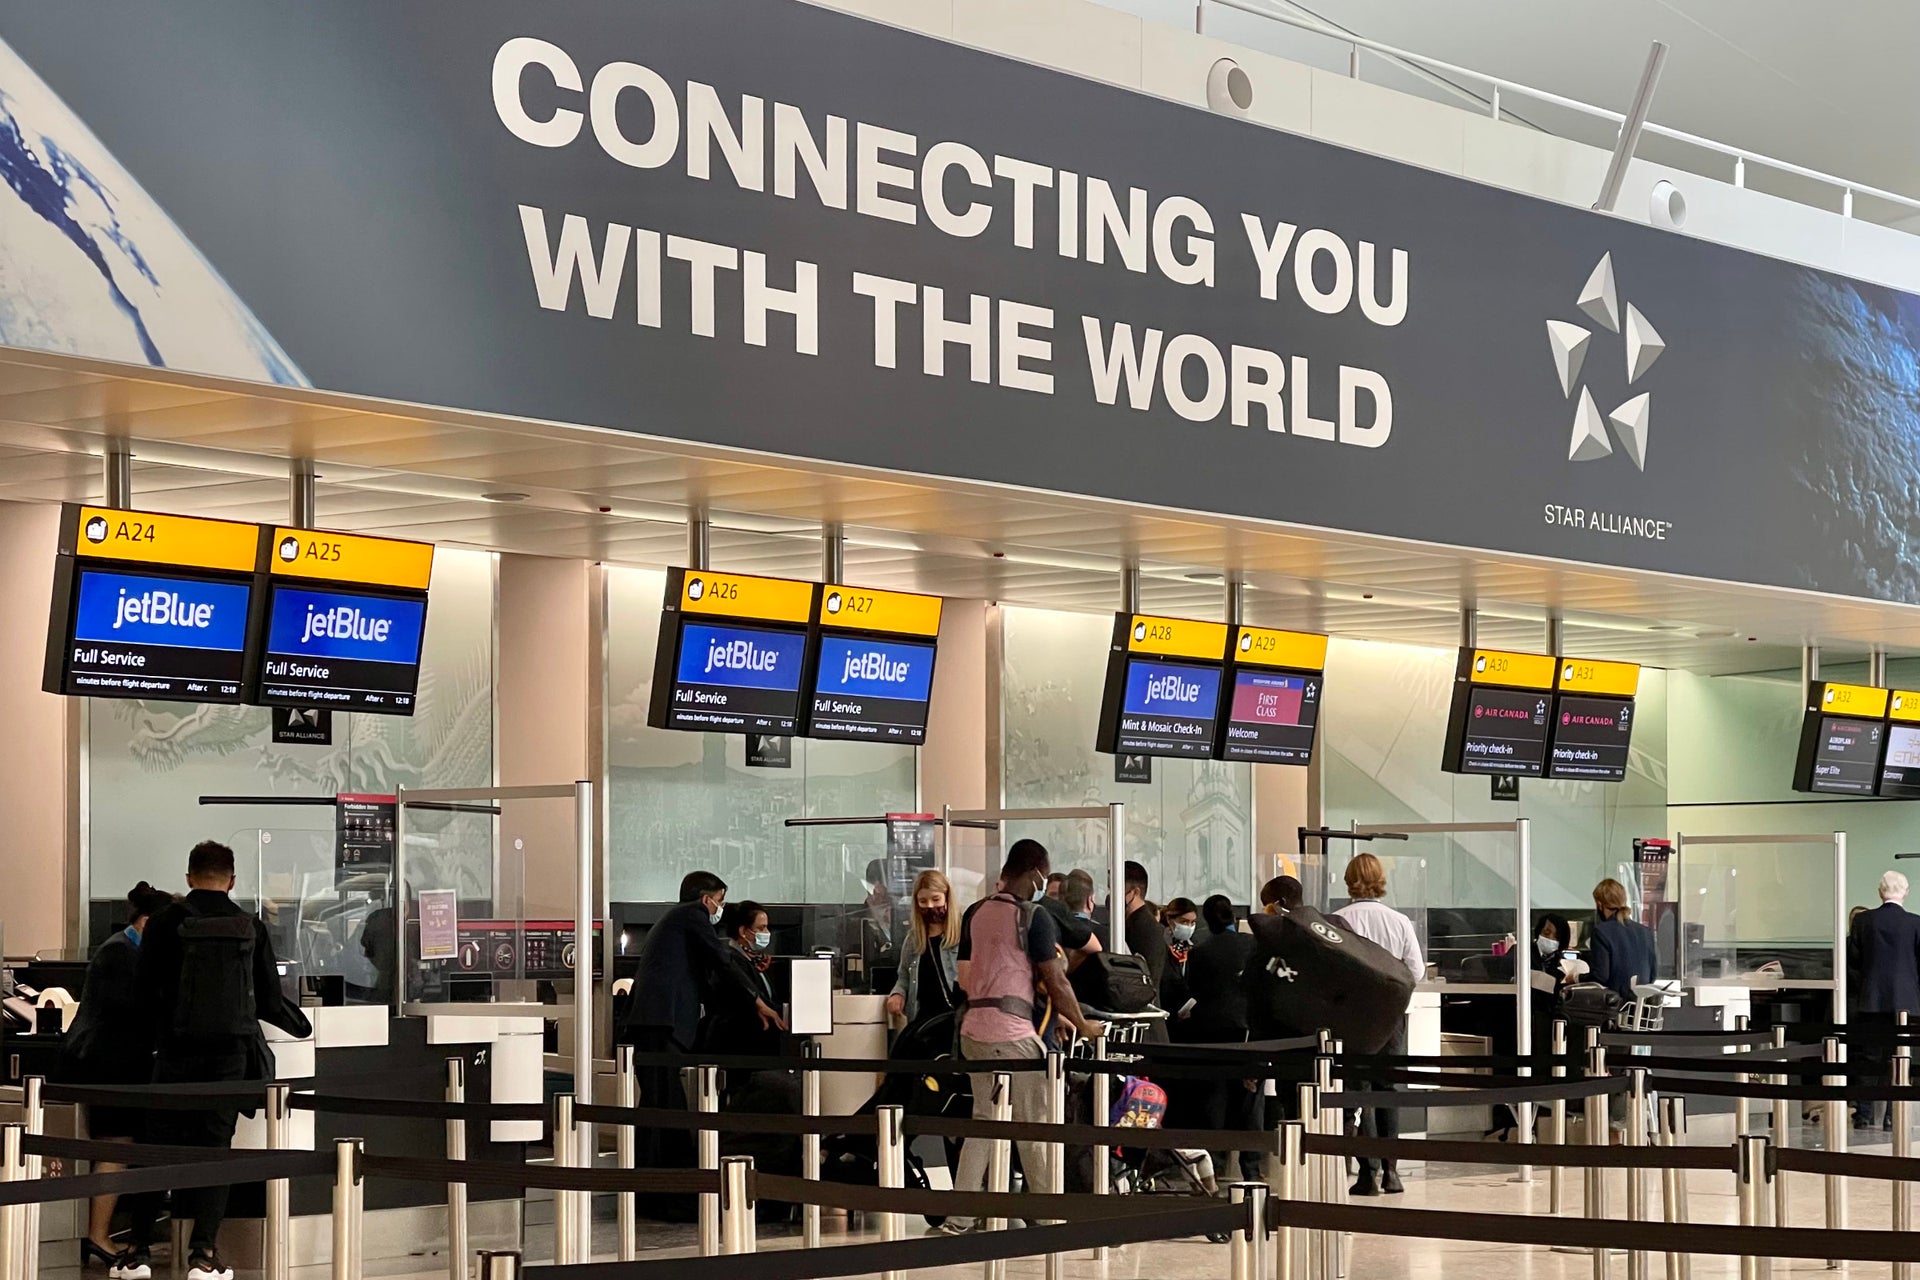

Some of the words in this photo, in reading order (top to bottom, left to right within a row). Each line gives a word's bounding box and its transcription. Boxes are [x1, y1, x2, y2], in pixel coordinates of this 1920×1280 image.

[492, 37, 1215, 288] CONNECTING
[1241, 212, 1409, 326] YOU
[518, 204, 818, 356] WITH
[853, 271, 1054, 394] THE
[1081, 315, 1393, 448] WORLD
[1544, 504, 1585, 528] STAR
[115, 521, 155, 543] A24
[305, 542, 341, 562] A25
[709, 582, 737, 600] A26
[113, 589, 213, 629] jetBlue
[846, 595, 873, 613] A27
[301, 604, 391, 643] jetBlue
[1150, 625, 1172, 640] A28
[1254, 636, 1276, 651] A29
[73, 648, 97, 663] Full
[100, 650, 146, 667] Service
[705, 638, 777, 673] jetBlue
[266, 661, 287, 676] Full
[289, 663, 329, 679] Service
[841, 650, 908, 684] jetBlue
[1489, 658, 1509, 672] A30
[1576, 667, 1594, 680] A31
[100, 678, 121, 687] before
[122, 680, 139, 690] flight
[140, 681, 170, 691] departure
[1144, 674, 1199, 704] jetBlue
[288, 688, 307, 698] before
[324, 692, 350, 701] departure
[675, 689, 693, 702] Full
[694, 690, 727, 705] Service
[1258, 692, 1279, 706] FIRST
[814, 699, 831, 712] Full
[831, 700, 862, 714] Service
[1256, 705, 1277, 718] CLASS
[1484, 708, 1498, 717] AIR
[1499, 709, 1529, 719] CANADA
[1122, 719, 1139, 731] Mint
[1140, 720, 1146, 731] &
[1147, 721, 1172, 733] Mosaic
[1571, 715, 1584, 724] AIR
[1585, 716, 1613, 726] CANADA
[1228, 727, 1259, 739] Welcome
[1466, 742, 1488, 755] Priority
[1488, 744, 1513, 755] check-in
[1553, 748, 1575, 761] Priority
